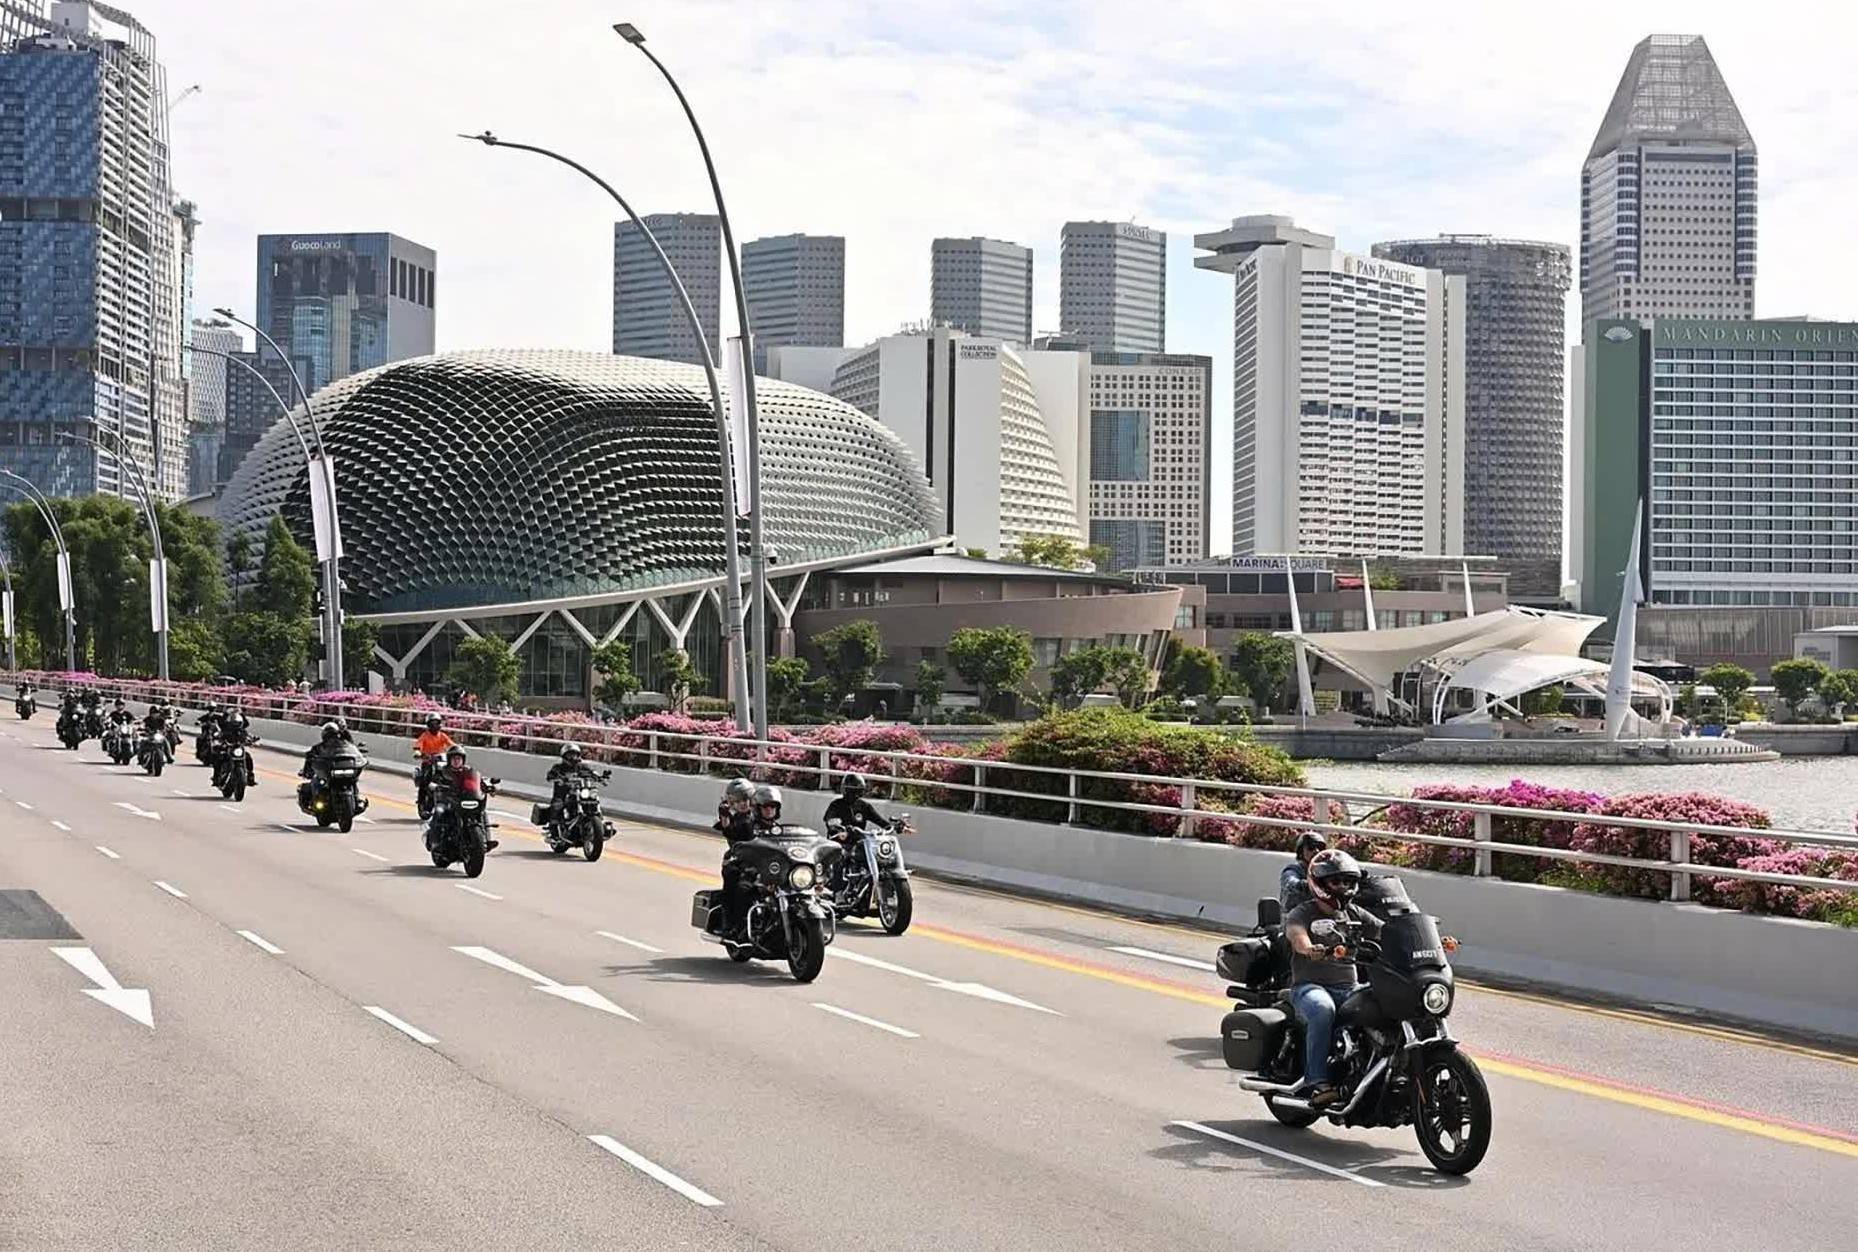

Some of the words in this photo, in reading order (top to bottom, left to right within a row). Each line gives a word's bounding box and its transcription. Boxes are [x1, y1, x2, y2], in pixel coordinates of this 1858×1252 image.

[1357, 260, 1376, 277] PAN
[1379, 264, 1416, 283] PACIFIC
[1663, 327, 1782, 341] MANDARIN
[1233, 559, 1279, 569] MARINA
